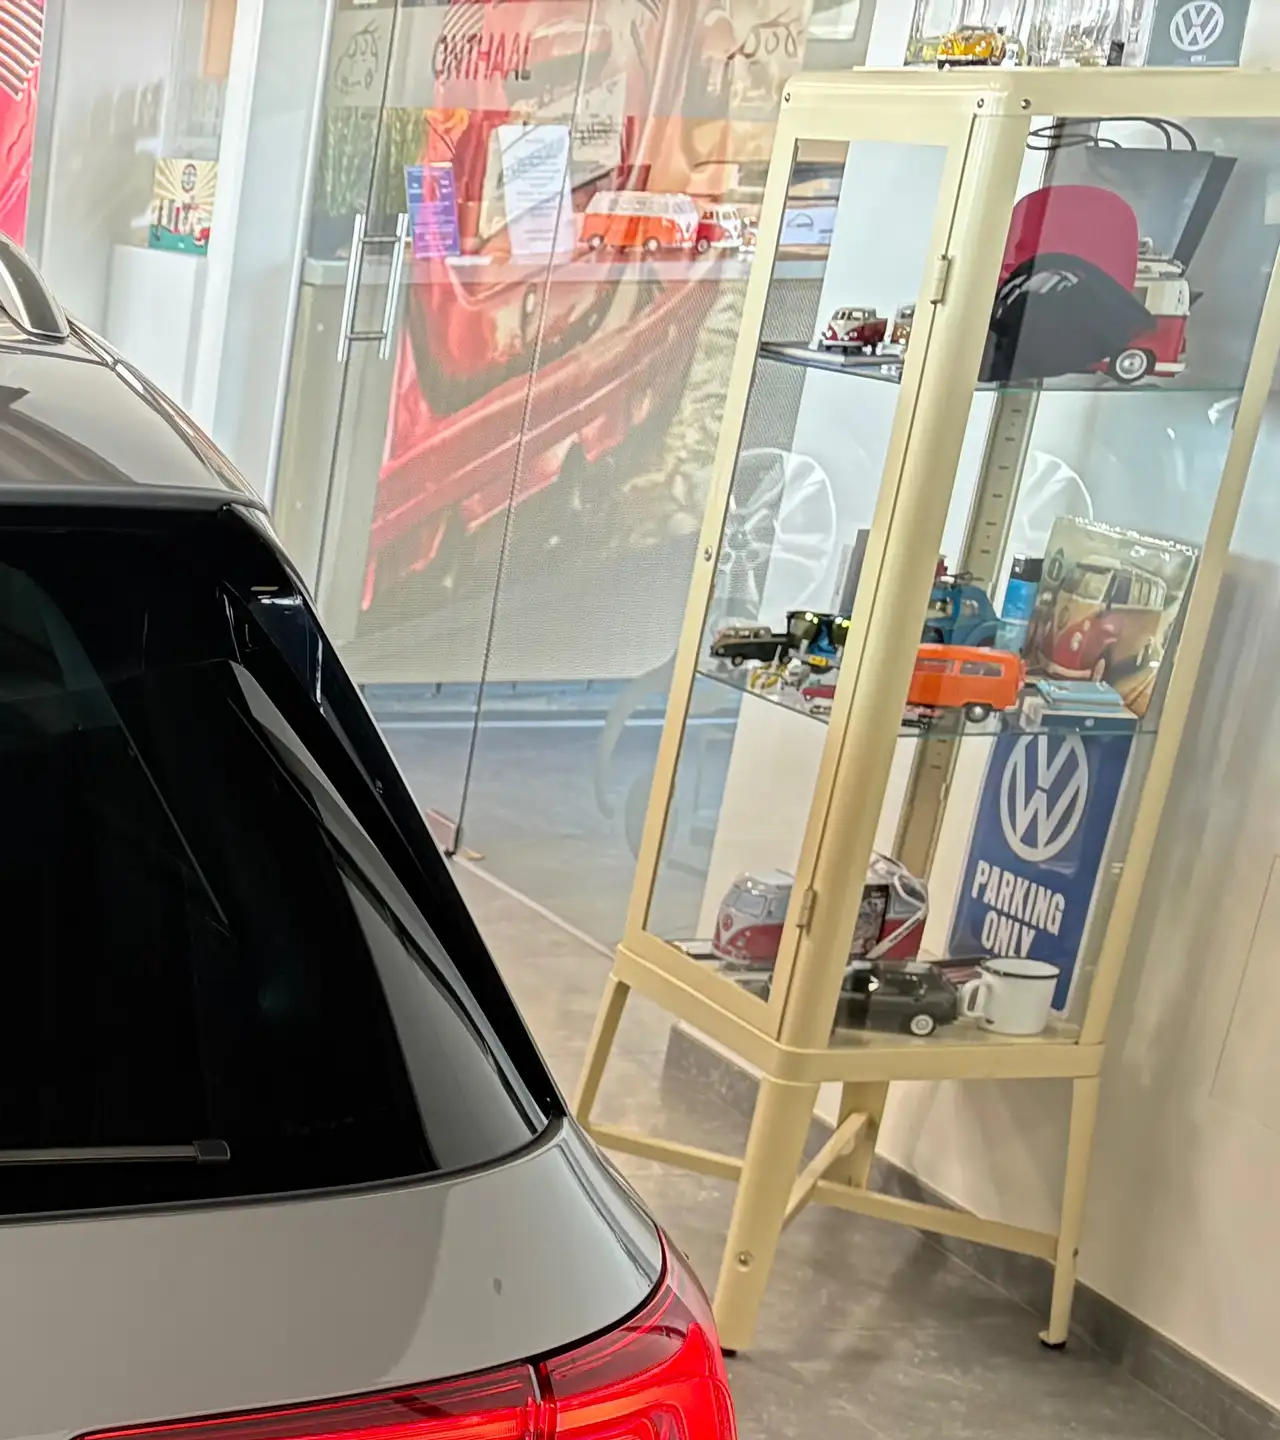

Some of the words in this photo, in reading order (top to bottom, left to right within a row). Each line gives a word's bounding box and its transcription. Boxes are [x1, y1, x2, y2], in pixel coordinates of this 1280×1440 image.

[431, 32, 532, 81] ONTHAAL
[971, 860, 1066, 937] PARKING
[981, 911, 1037, 959] ONLY
